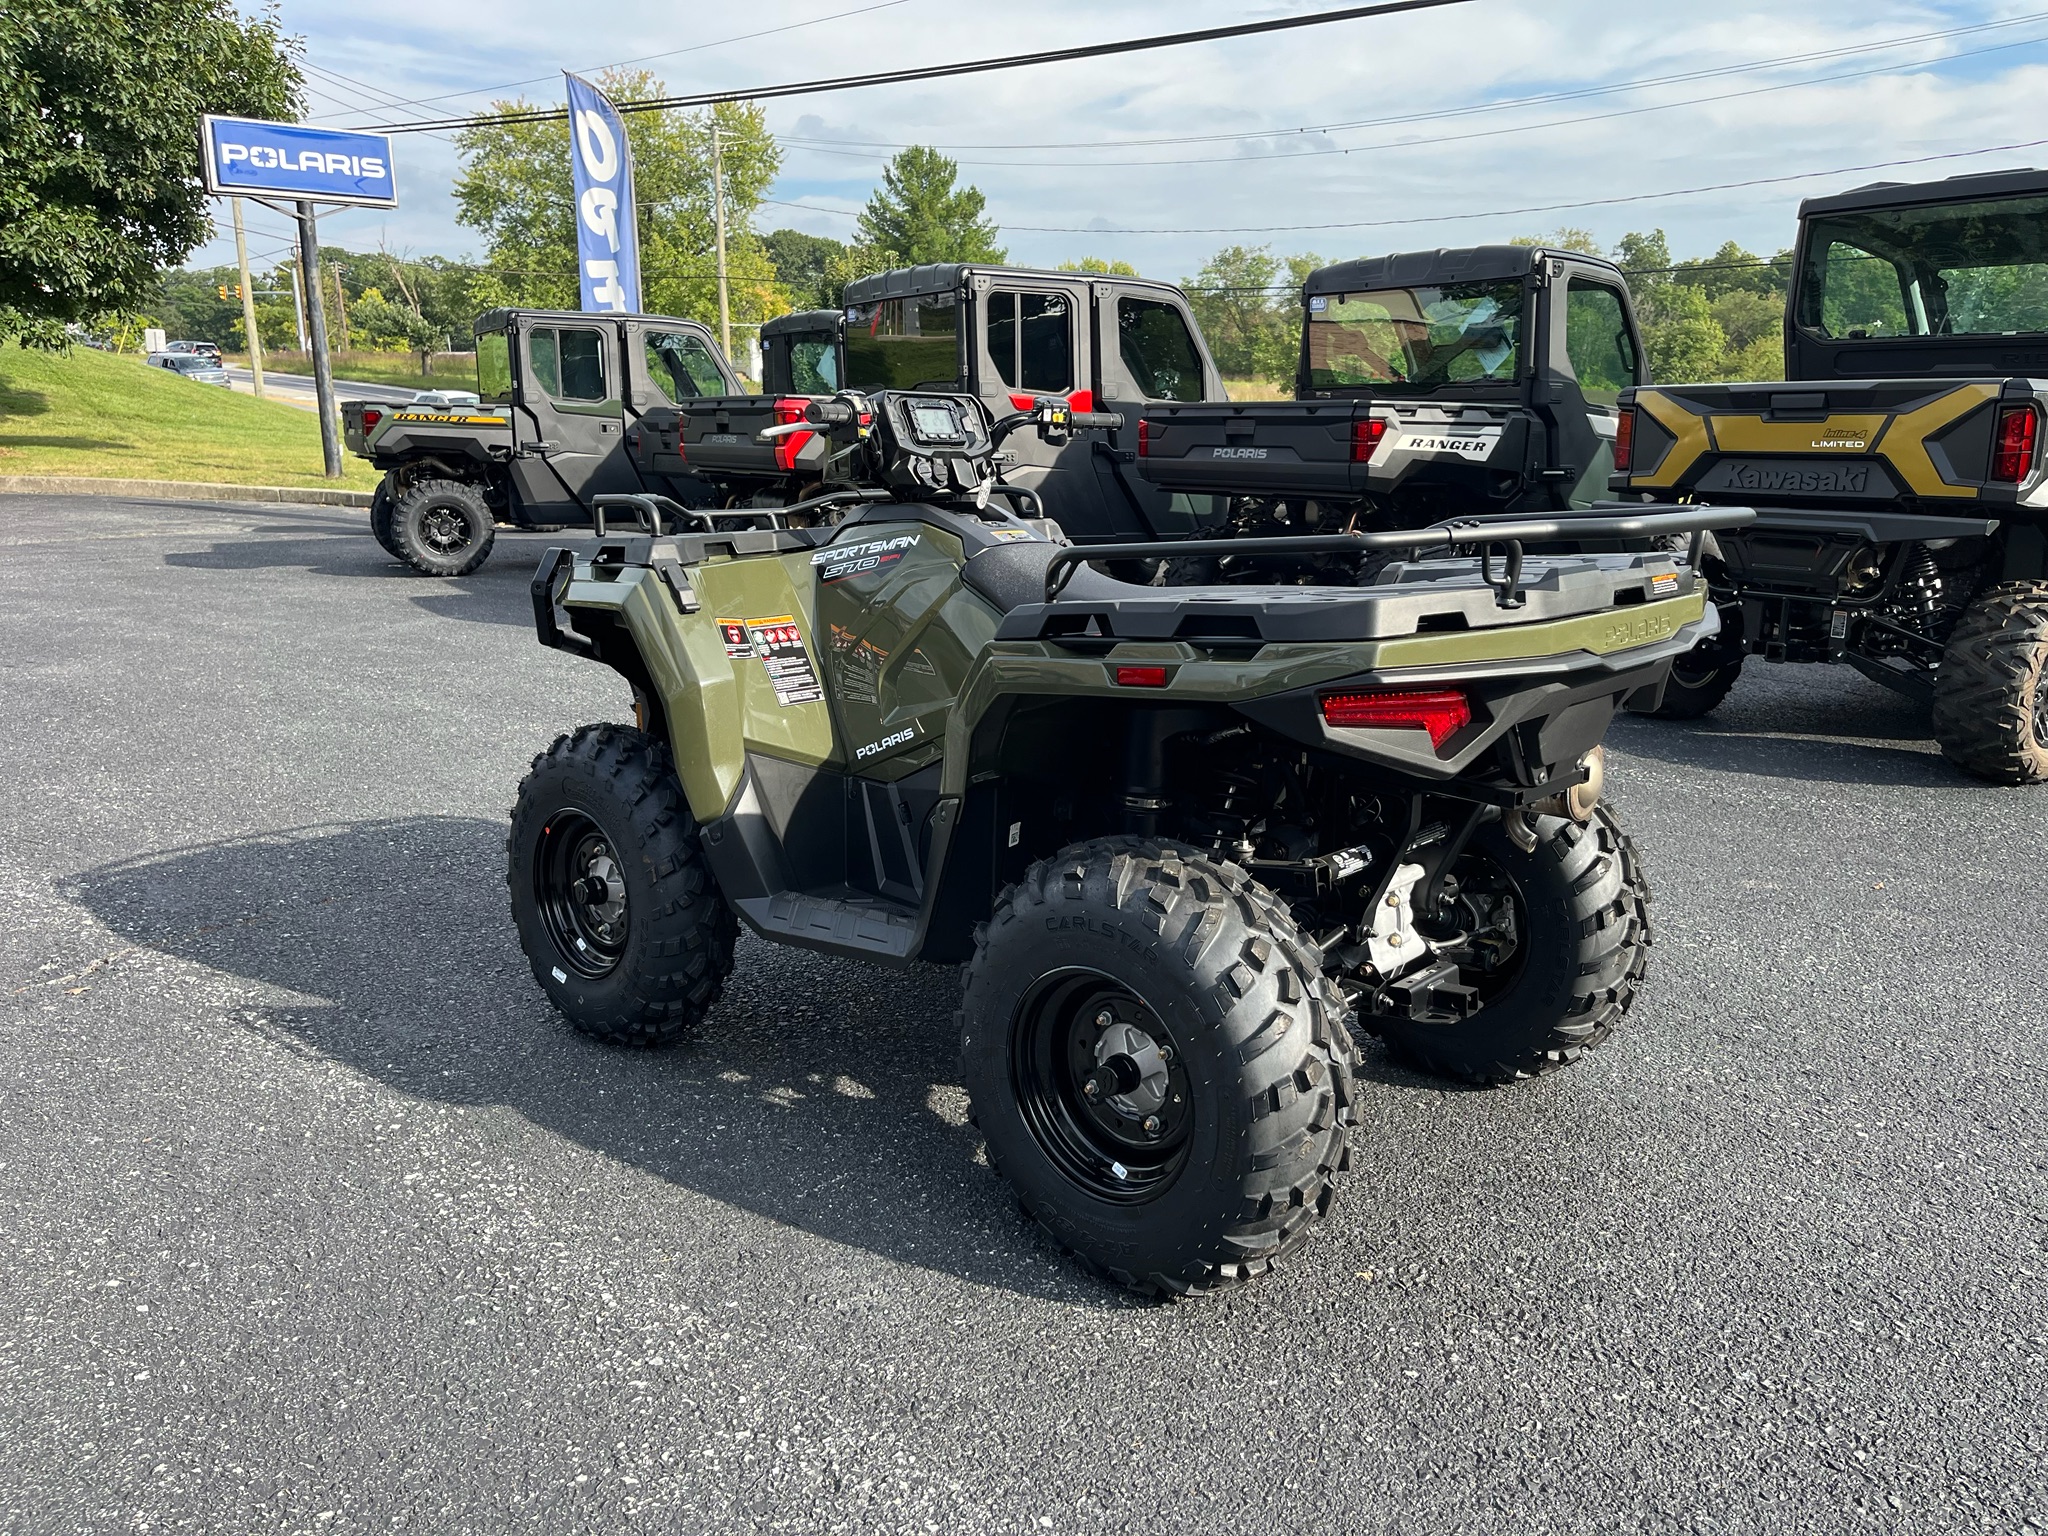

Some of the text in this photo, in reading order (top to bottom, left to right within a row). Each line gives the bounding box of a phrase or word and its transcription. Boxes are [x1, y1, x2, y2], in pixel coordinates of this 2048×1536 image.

[221, 143, 386, 179] POLARIS
[711, 435, 738, 443] POLARIS
[1212, 447, 1268, 459] POLARIS
[1409, 437, 1487, 452] RANGER
[1811, 440, 1865, 448] LIMITED
[1722, 464, 1869, 492] Kawasaki
[810, 534, 921, 565] SPORTSMAN
[823, 555, 880, 579] 570
[1604, 613, 1671, 648] POLARIS
[855, 727, 915, 760] POLARIS
[1045, 915, 1160, 968] CARLSTAR
